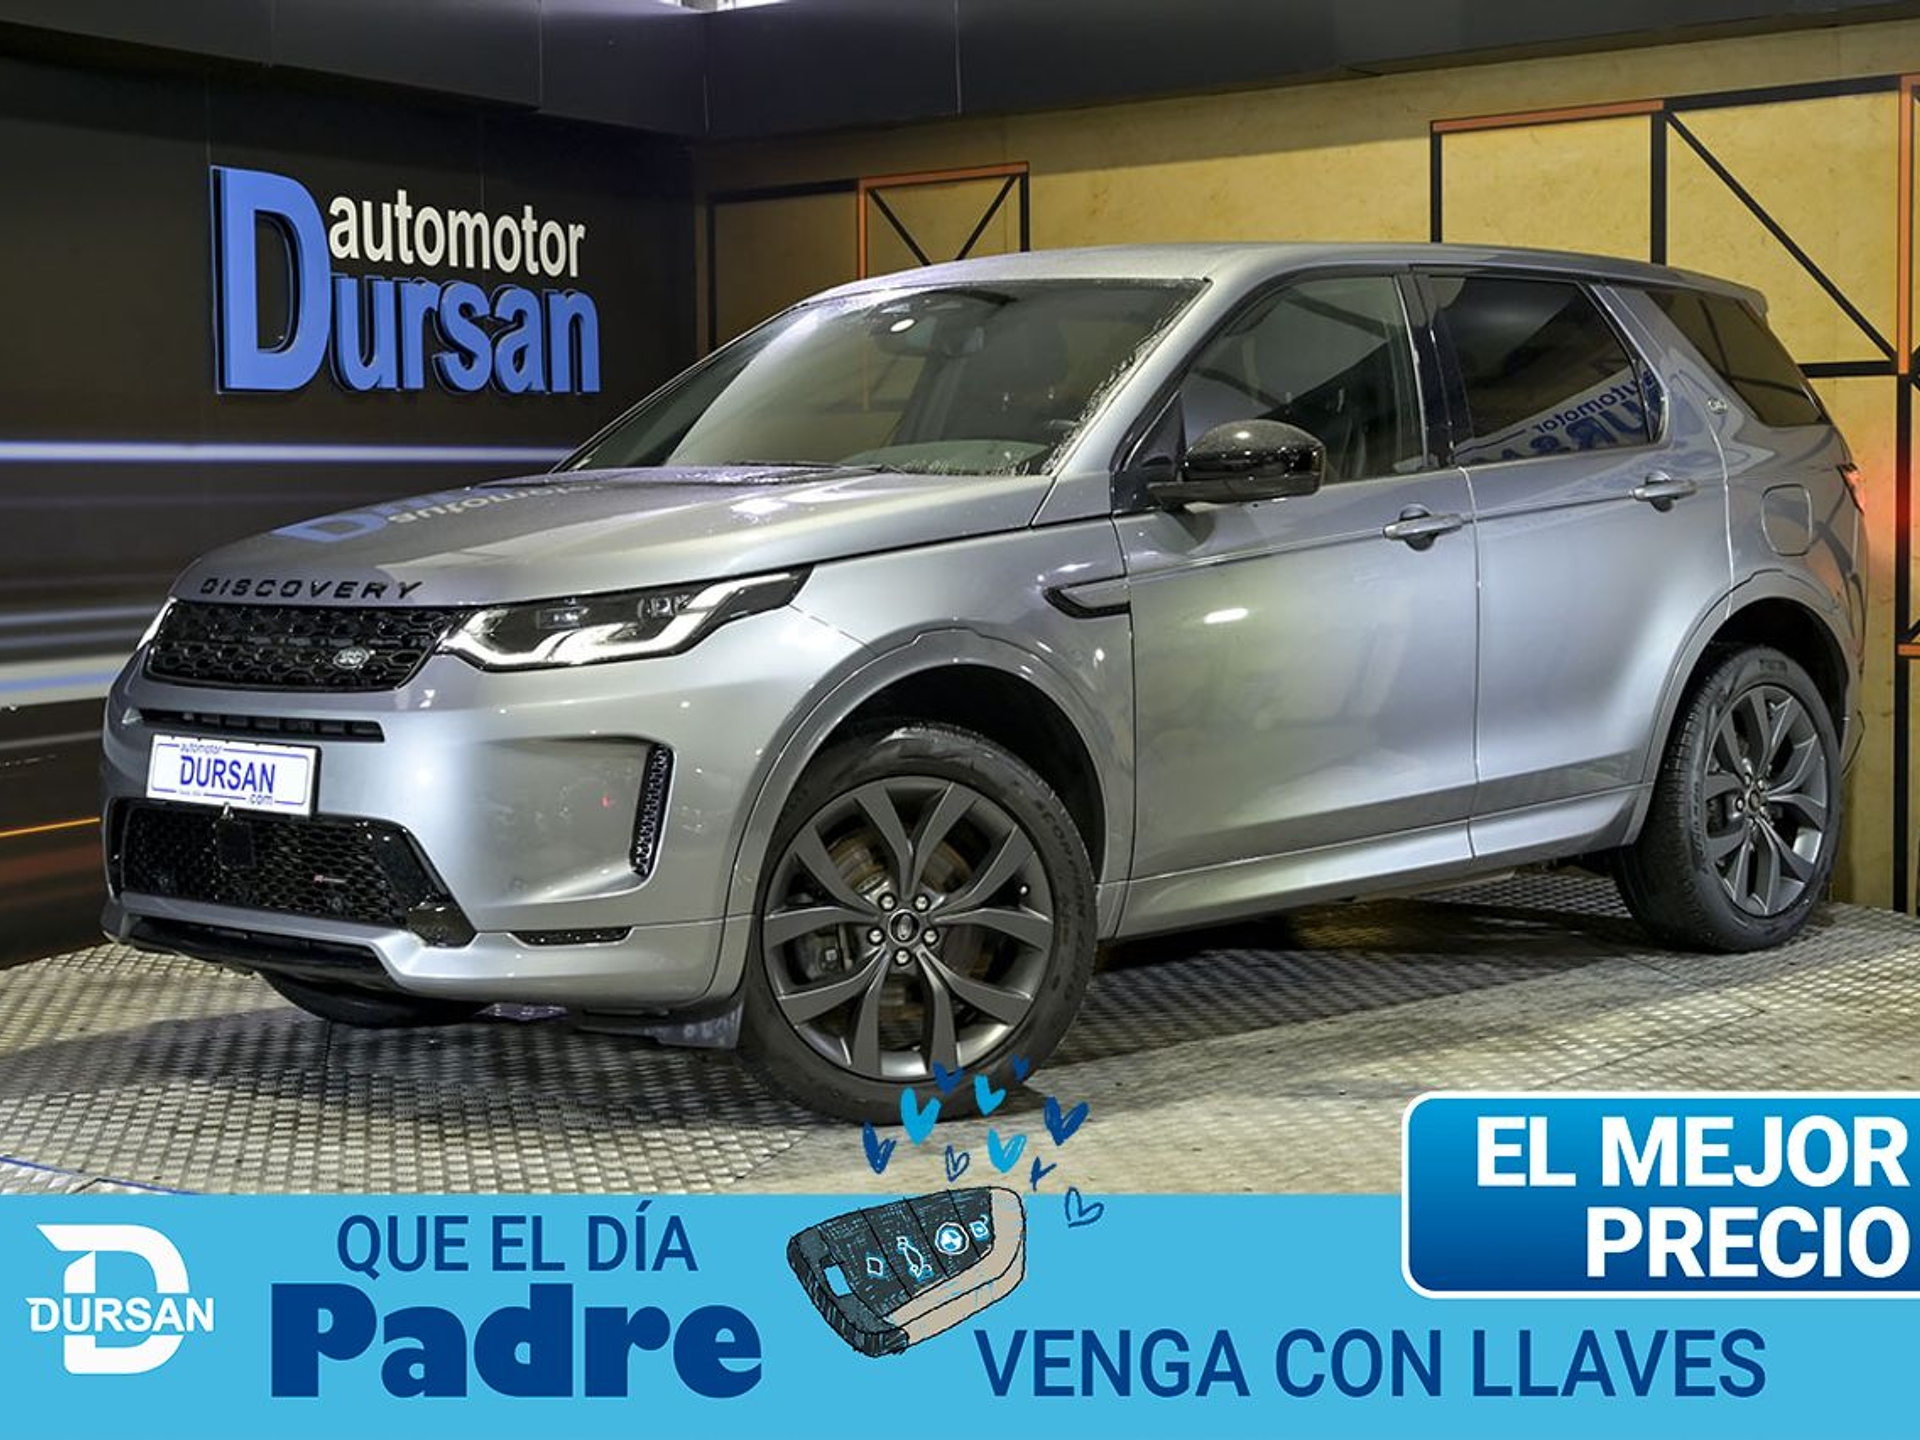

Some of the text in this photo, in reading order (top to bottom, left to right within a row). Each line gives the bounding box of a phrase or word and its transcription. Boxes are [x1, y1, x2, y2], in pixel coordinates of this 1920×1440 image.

[329, 189, 586, 278] automotor
[211, 165, 600, 394] Dursan
[200, 577, 423, 599] DISCOVERY
[180, 755, 276, 794] DURSAN
